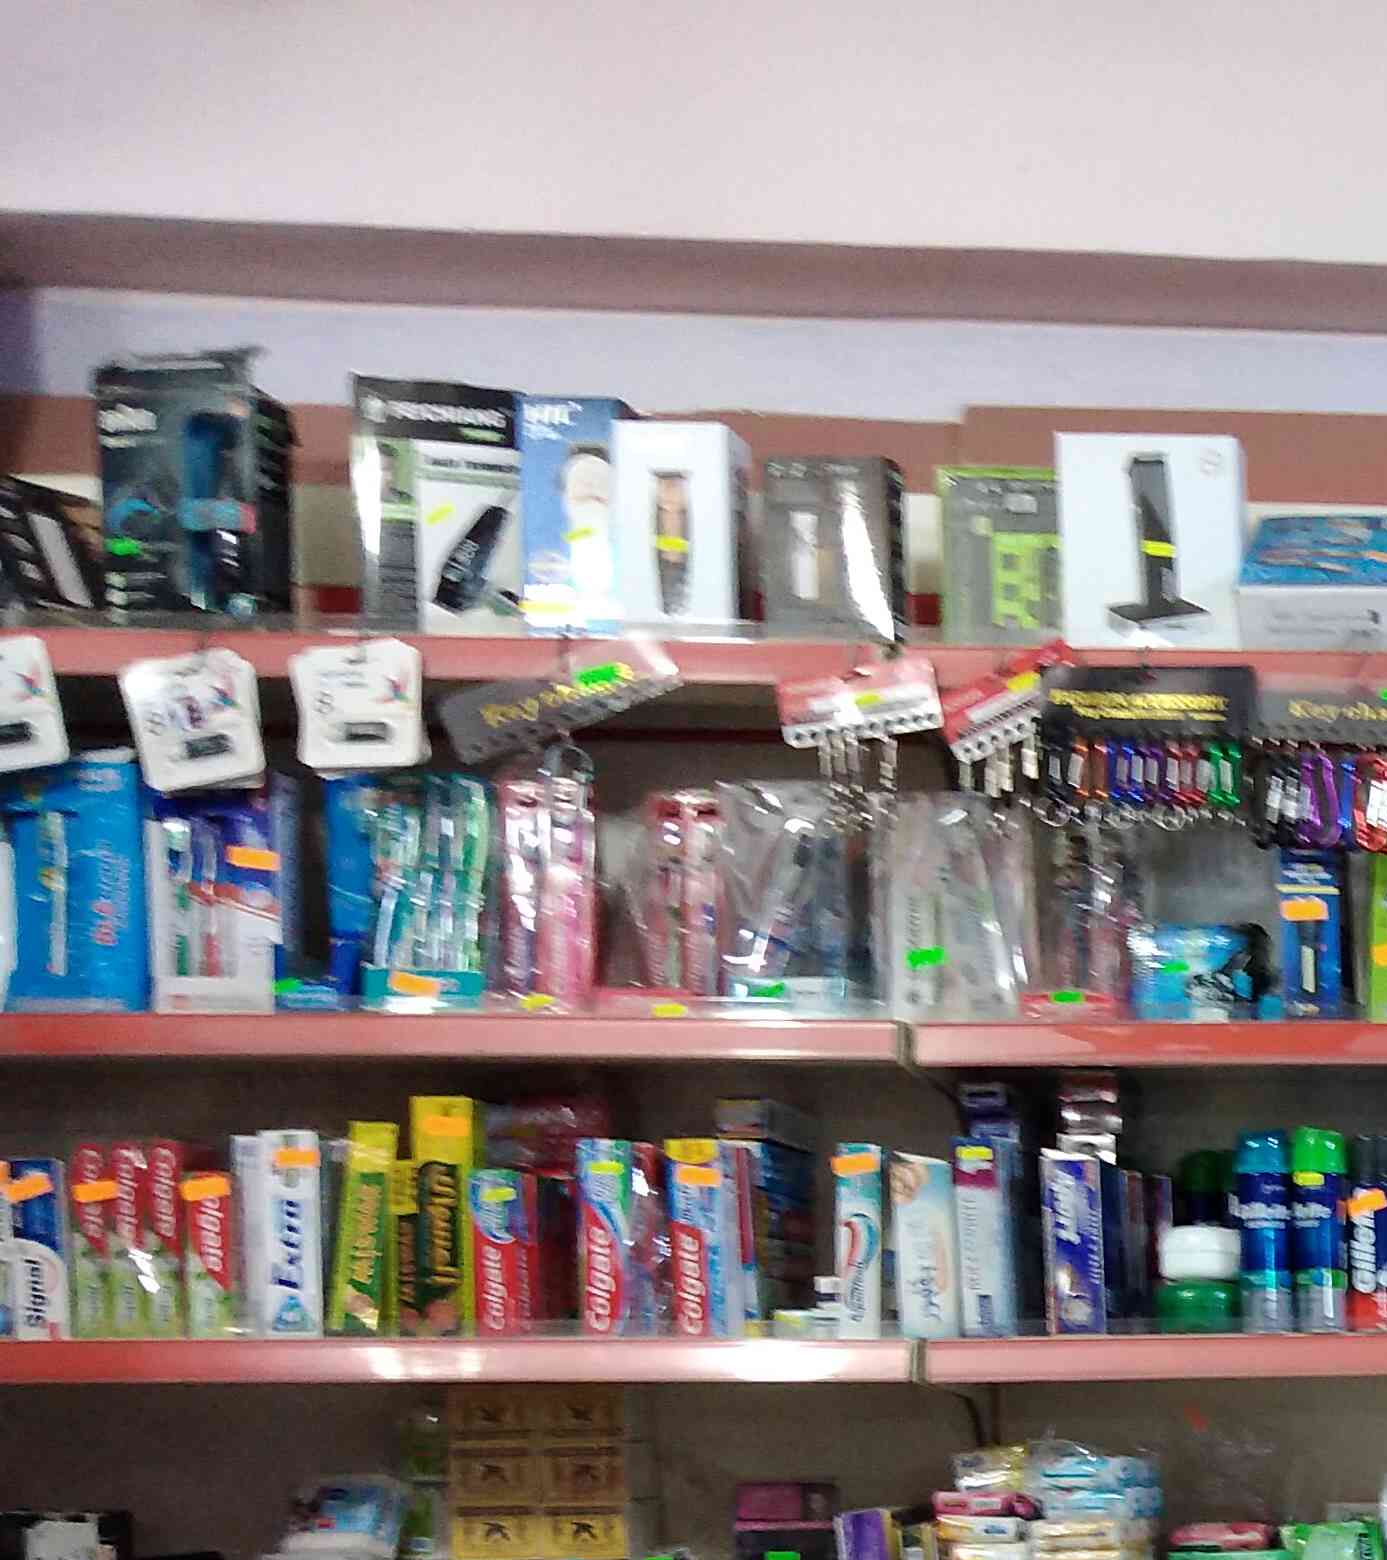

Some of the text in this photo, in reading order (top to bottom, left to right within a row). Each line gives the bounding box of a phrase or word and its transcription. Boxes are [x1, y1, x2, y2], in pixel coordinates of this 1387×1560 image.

[482, 1245, 507, 1330] Colgate
[585, 1226, 617, 1331] Colgate
[677, 1233, 706, 1335] Colgate
